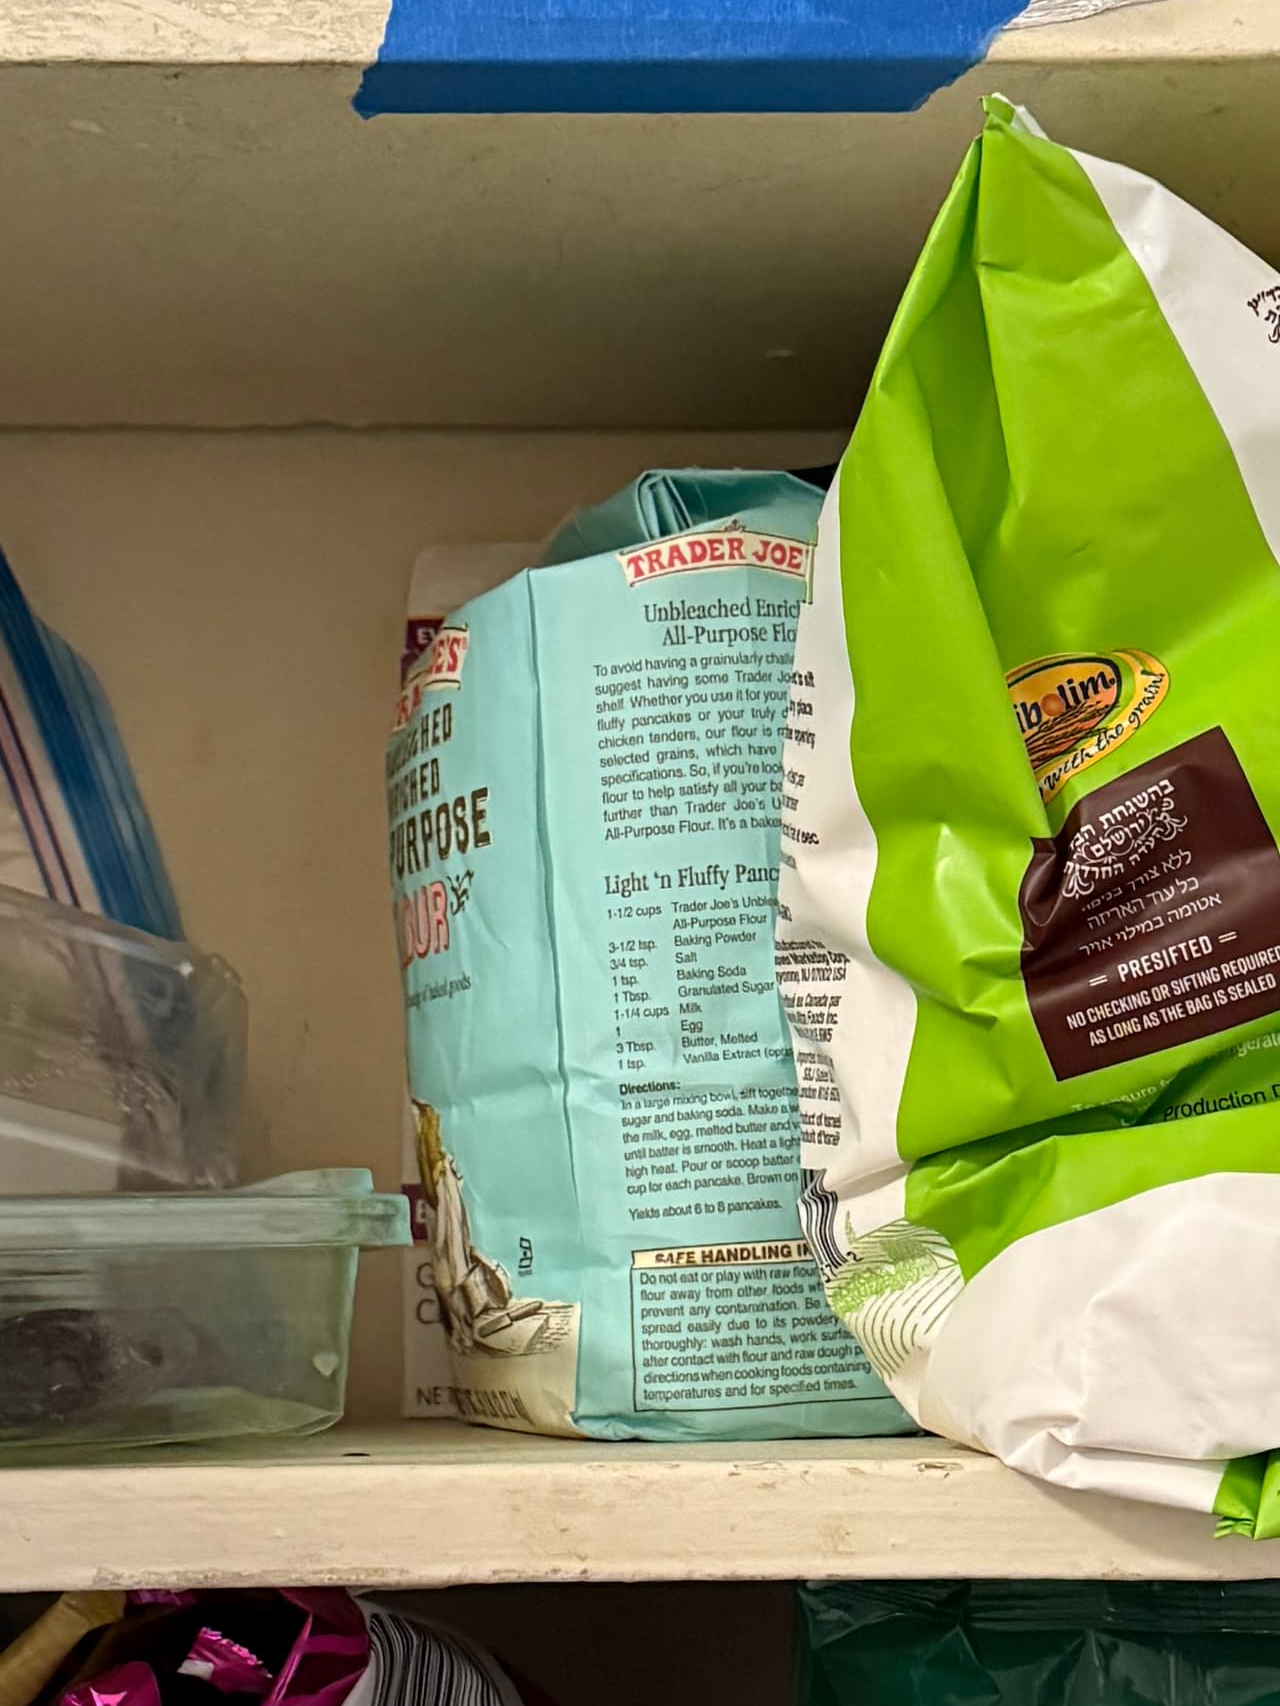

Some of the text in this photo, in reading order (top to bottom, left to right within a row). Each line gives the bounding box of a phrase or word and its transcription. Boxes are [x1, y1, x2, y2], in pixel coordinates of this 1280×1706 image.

[626, 536, 746, 580] TRADER
[643, 596, 752, 623] Unbleached
[662, 624, 768, 647] All-Purpose
[594, 664, 609, 677] To
[610, 662, 643, 677] avoid
[645, 656, 687, 672] having
[689, 658, 698, 667] a
[1043, 748, 1094, 791] with
[604, 872, 650, 898] Light
[677, 864, 730, 891] Fluffy
[607, 897, 740, 919] 1-1/2 cups Trader Joe's
[672, 913, 768, 931] All-Purpose Flour
[674, 931, 757, 948] Baking Powder
[676, 951, 698, 964] Salt
[1117, 934, 1214, 983] PRESIFTED
[677, 965, 747, 982] Baking Soda
[678, 980, 775, 998] Granulated Sugar
[1066, 1011, 1086, 1030] NO
[1087, 992, 1152, 1024] CHECKING
[1151, 985, 1170, 1003] OR
[1170, 970, 1221, 996] SIFTING
[1089, 973, 1278, 1048] AS LONG AS THE BAG IS SEALED
[619, 1081, 681, 1096] Directions:
[654, 1244, 793, 1265] SAFE HANDLING
